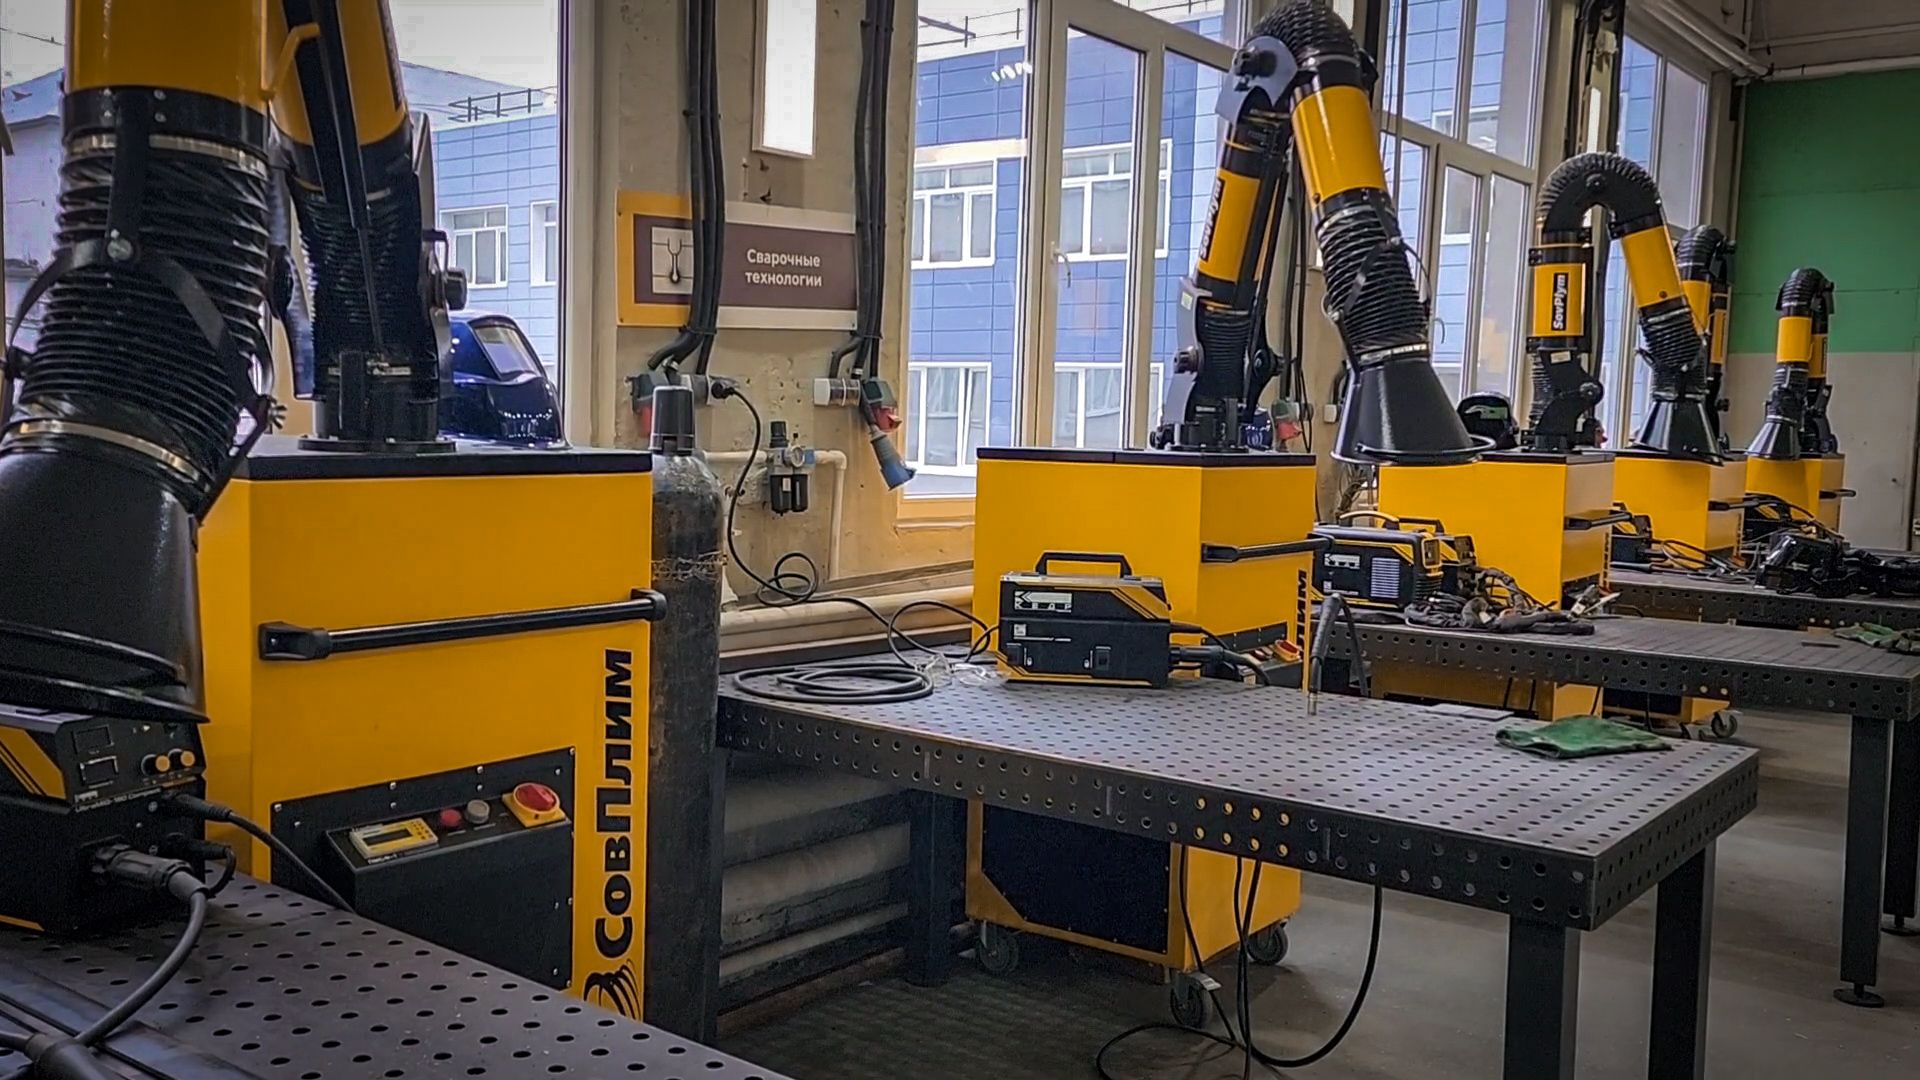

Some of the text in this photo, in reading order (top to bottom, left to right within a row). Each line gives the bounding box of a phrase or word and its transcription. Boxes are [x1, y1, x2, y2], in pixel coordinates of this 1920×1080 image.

[747, 249, 821, 268] Сварочные
[745, 271, 822, 288] технологии
[1553, 274, 1567, 329] SovPlym
